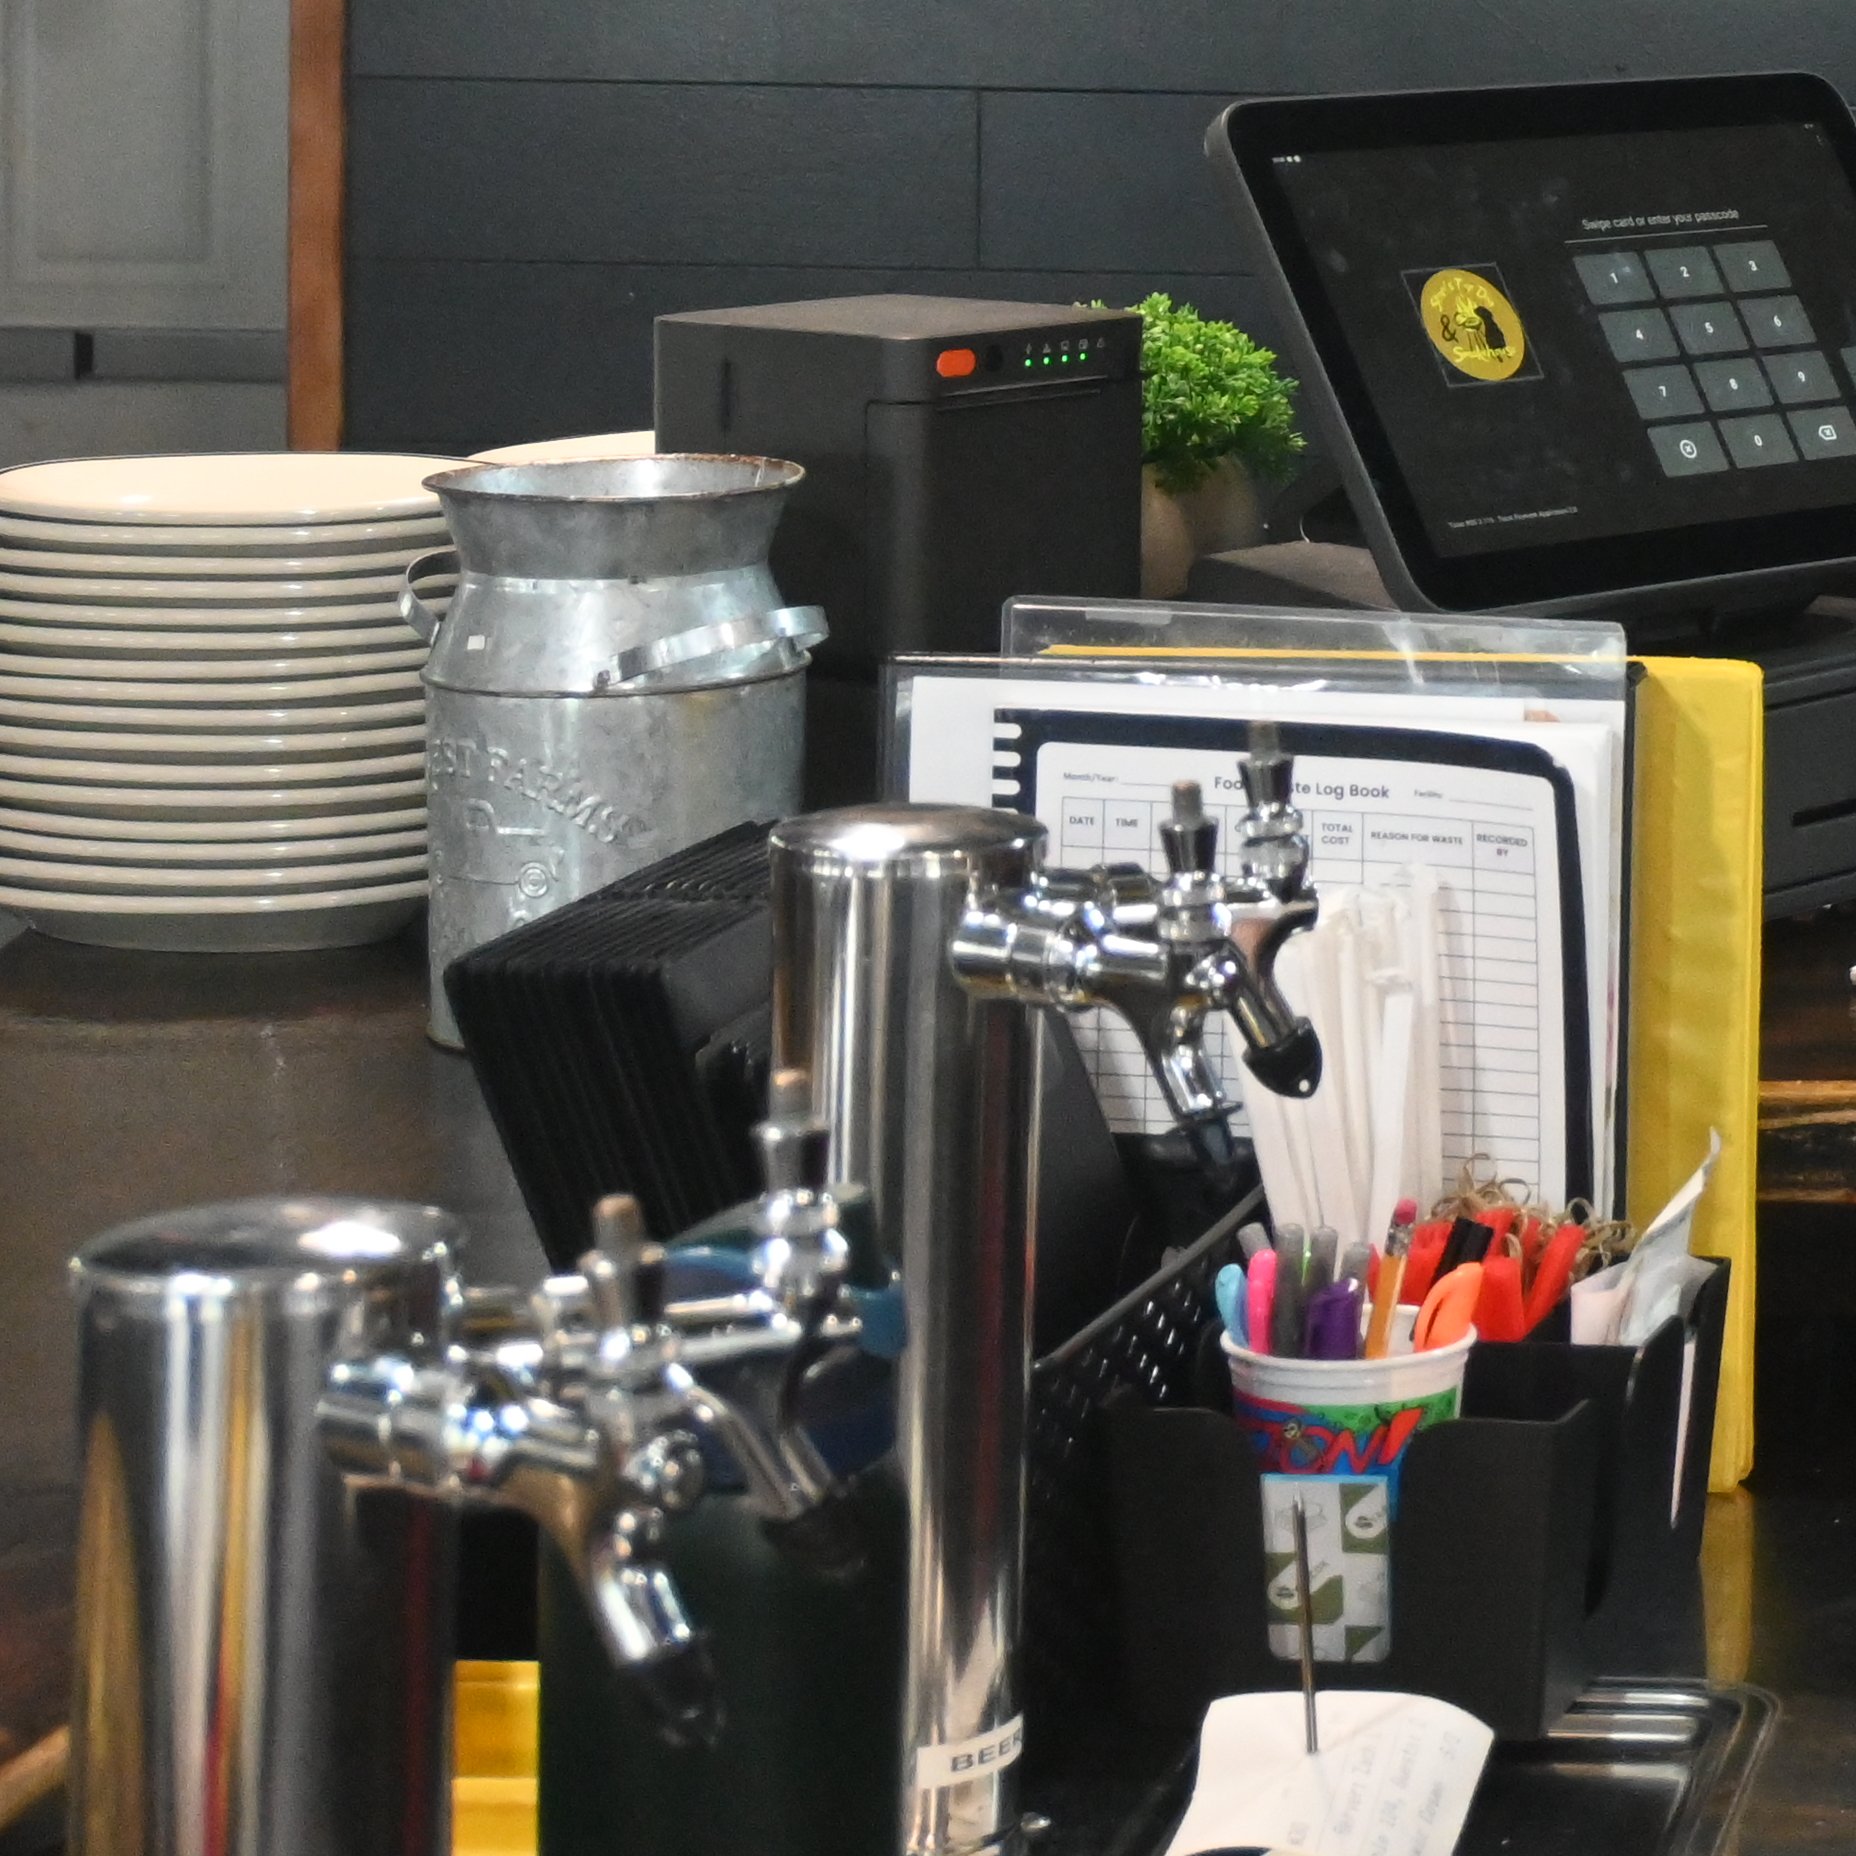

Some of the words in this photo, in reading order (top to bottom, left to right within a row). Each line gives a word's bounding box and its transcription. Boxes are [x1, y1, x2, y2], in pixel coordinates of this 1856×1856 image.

[1581, 218, 1611, 232] Swipe
[1612, 215, 1635, 228] card
[1635, 217, 1647, 227] or
[1647, 214, 1672, 226] enter
[1672, 213, 1692, 226] your
[1694, 208, 1740, 223] passcode
[1610, 272, 1619, 284] 1
[1680, 266, 1690, 277] 2
[1749, 260, 1758, 272] 3
[1635, 329, 1644, 340] 4
[1704, 322, 1714, 334] 5
[1773, 315, 1782, 327] 6
[1659, 385, 1667, 397] 7
[1729, 378, 1739, 390] 8
[1797, 371, 1806, 383] 9
[1754, 434, 1763, 447] 0
[1214, 776, 1244, 791] Foo
[1316, 782, 1345, 800] Log
[1349, 783, 1390, 799] Book
[1069, 816, 1095, 827] DATE
[1115, 817, 1139, 828] TIME
[1321, 822, 1353, 834] TOTAL
[1321, 834, 1350, 845] COST
[1370, 830, 1409, 841] REASON
[1410, 832, 1429, 843] FOR
[1431, 835, 1464, 845] WASTE
[1476, 833, 1529, 848] RECORDED
[1496, 847, 1509, 857] BY
